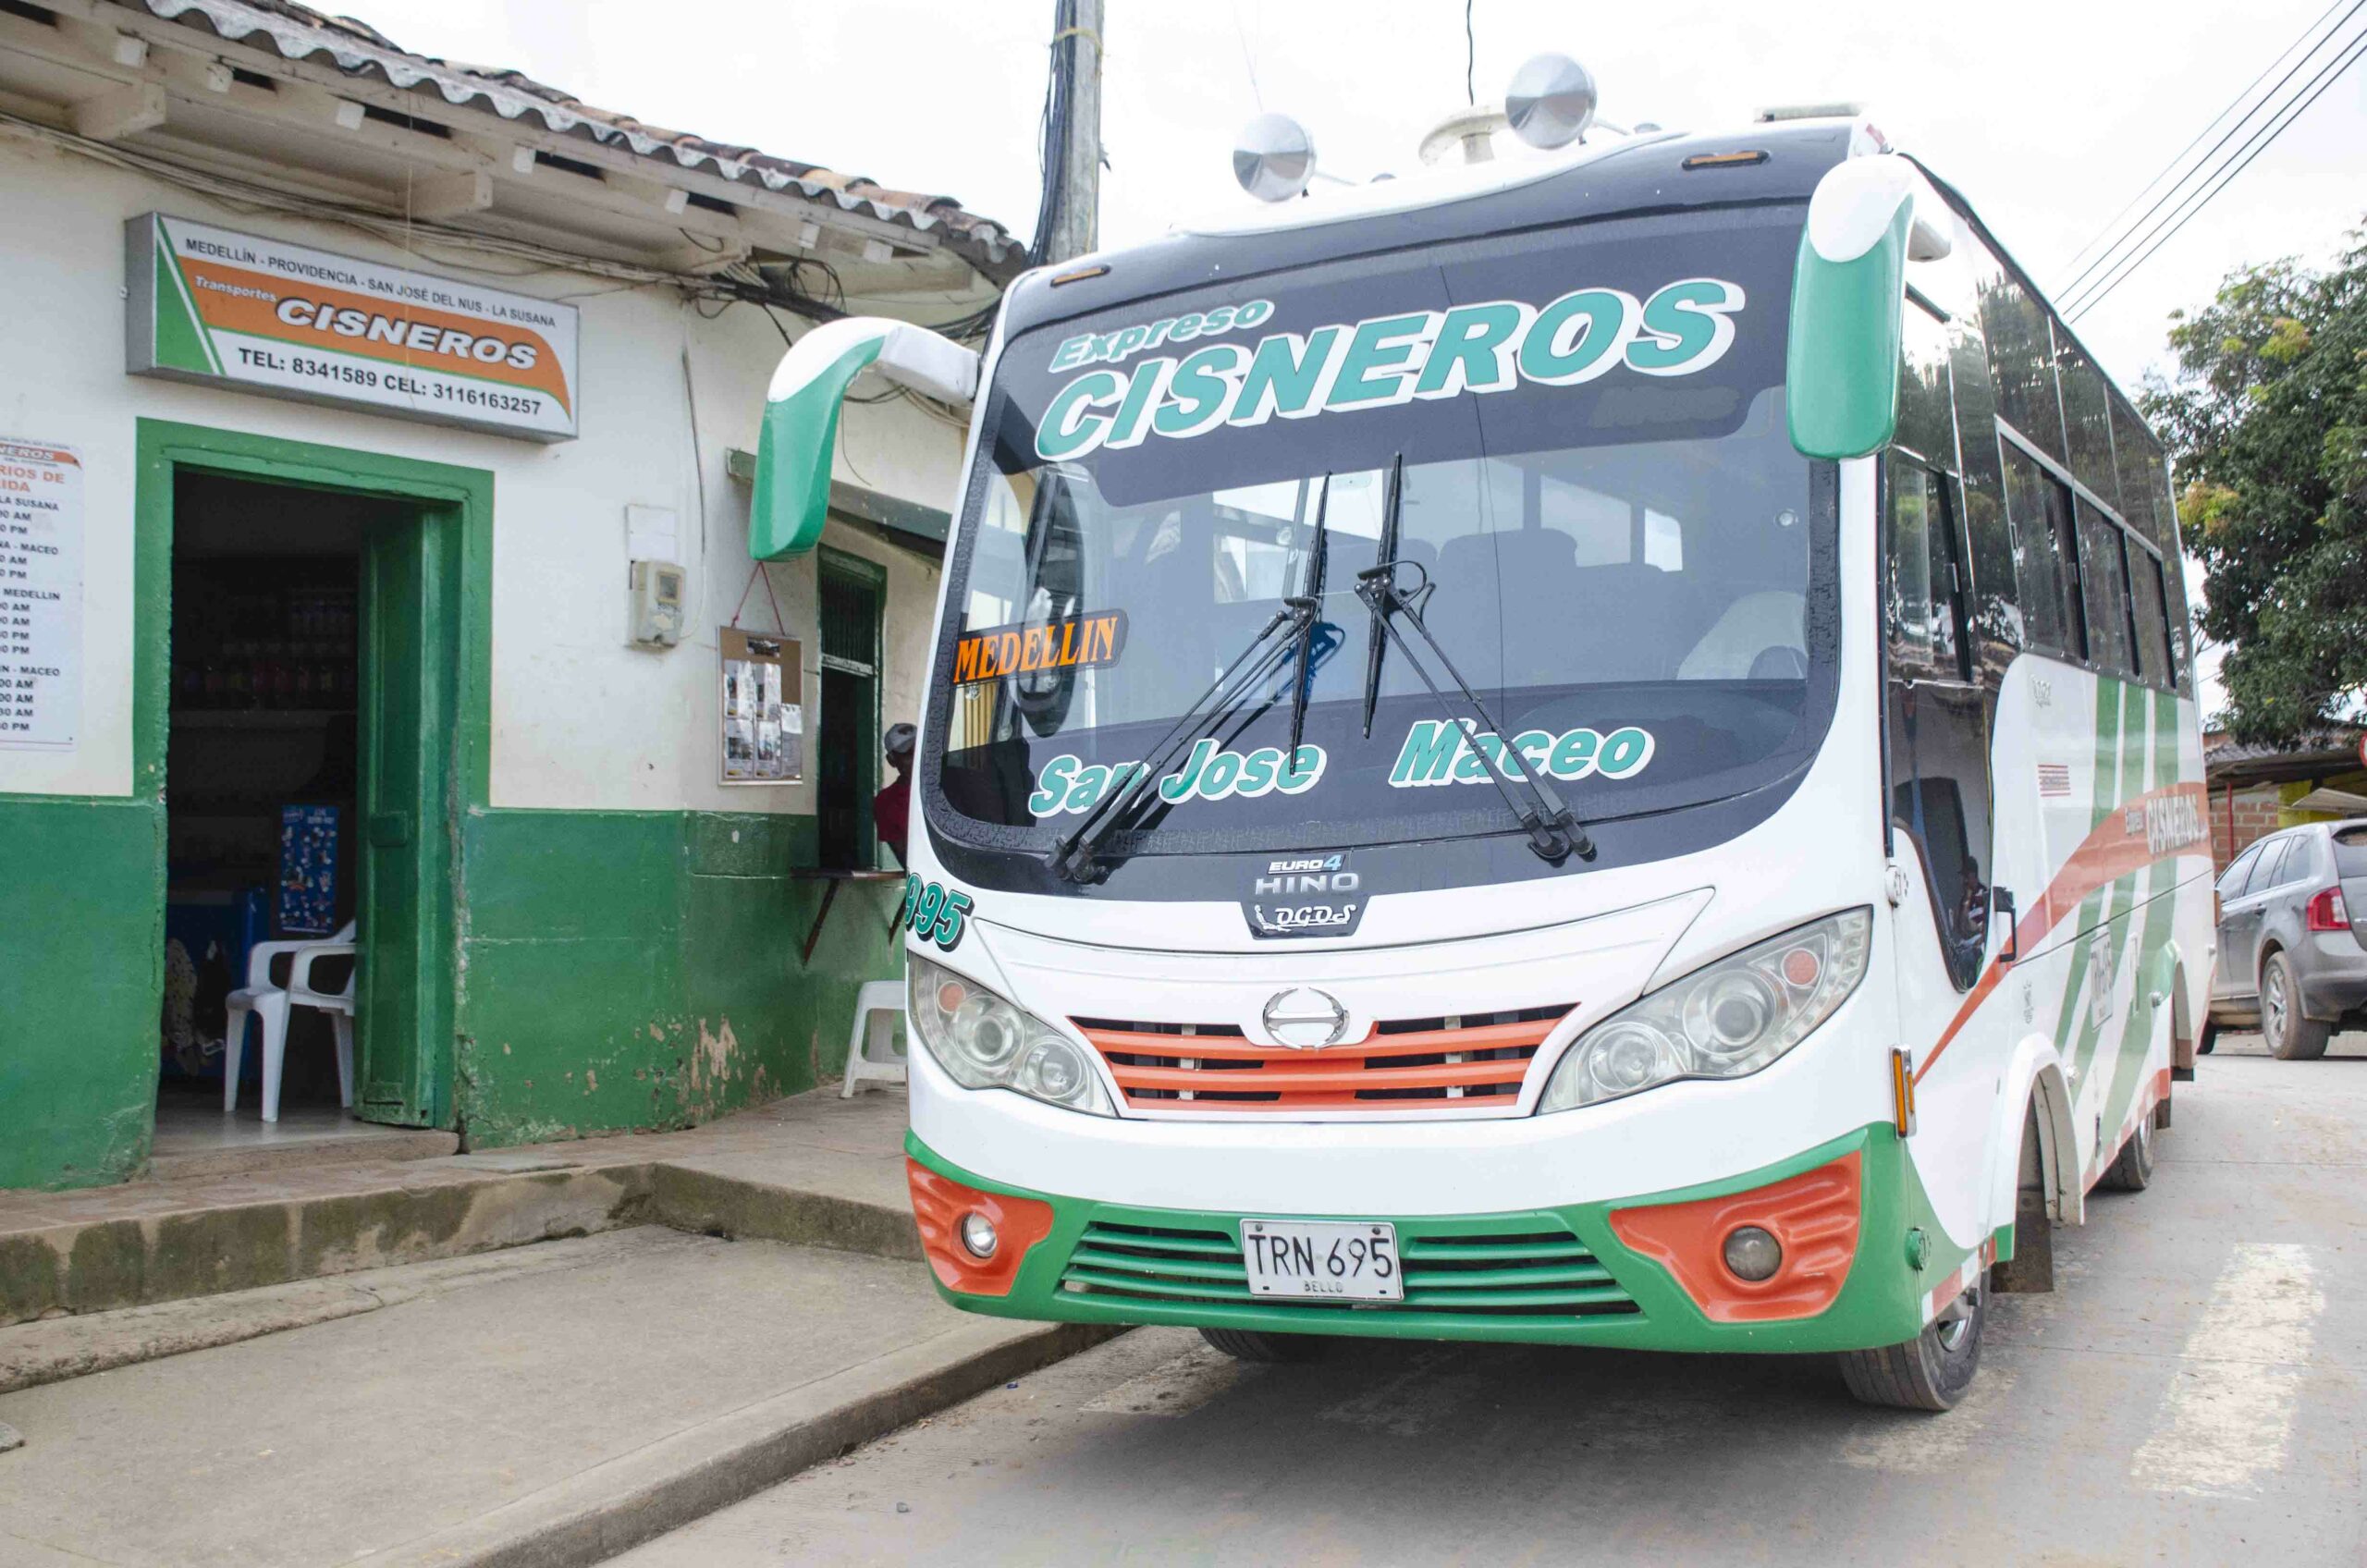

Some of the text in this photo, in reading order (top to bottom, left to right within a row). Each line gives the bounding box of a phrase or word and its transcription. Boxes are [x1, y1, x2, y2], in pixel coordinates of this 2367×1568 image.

[268, 256, 358, 287] PROVIDENCIA
[368, 278, 394, 293] SAN
[432, 292, 456, 307] DEL
[459, 298, 483, 312] NUS
[493, 305, 507, 317] LA
[509, 309, 557, 327] SUSANA
[195, 276, 538, 370] Transportes CISNEROS
[1049, 300, 1275, 373] Expreso
[1034, 277, 1746, 461] CISNEROS
[239, 348, 541, 416] TEL: 8341589 CEL: 3116163257
[43, 471, 66, 484] DE
[16, 497, 59, 511] SUSANA
[14, 511, 31, 521] AM
[10, 524, 28, 534] PM
[20, 542, 58, 555] MACEO
[9, 556, 27, 566] AM
[9, 570, 27, 580] PM
[4, 588, 60, 601] MEDELLIN
[13, 603, 30, 613] AM
[13, 617, 30, 627] AM
[12, 631, 30, 641] PM
[12, 645, 30, 655] PM
[953, 617, 1118, 684] MEDELLIN
[20, 666, 60, 677] MACEO
[16, 680, 33, 690] AM
[16, 693, 33, 704] AM
[16, 708, 33, 717] AM
[12, 723, 30, 732] PM
[1388, 717, 1655, 788] Maceo
[1159, 738, 1327, 805] Jose
[1269, 854, 1343, 872] EURO4
[1255, 872, 1359, 895] HINO
[1247, 1234, 1392, 1279] TRN 695
[1304, 1280, 1344, 1293] BELLO
